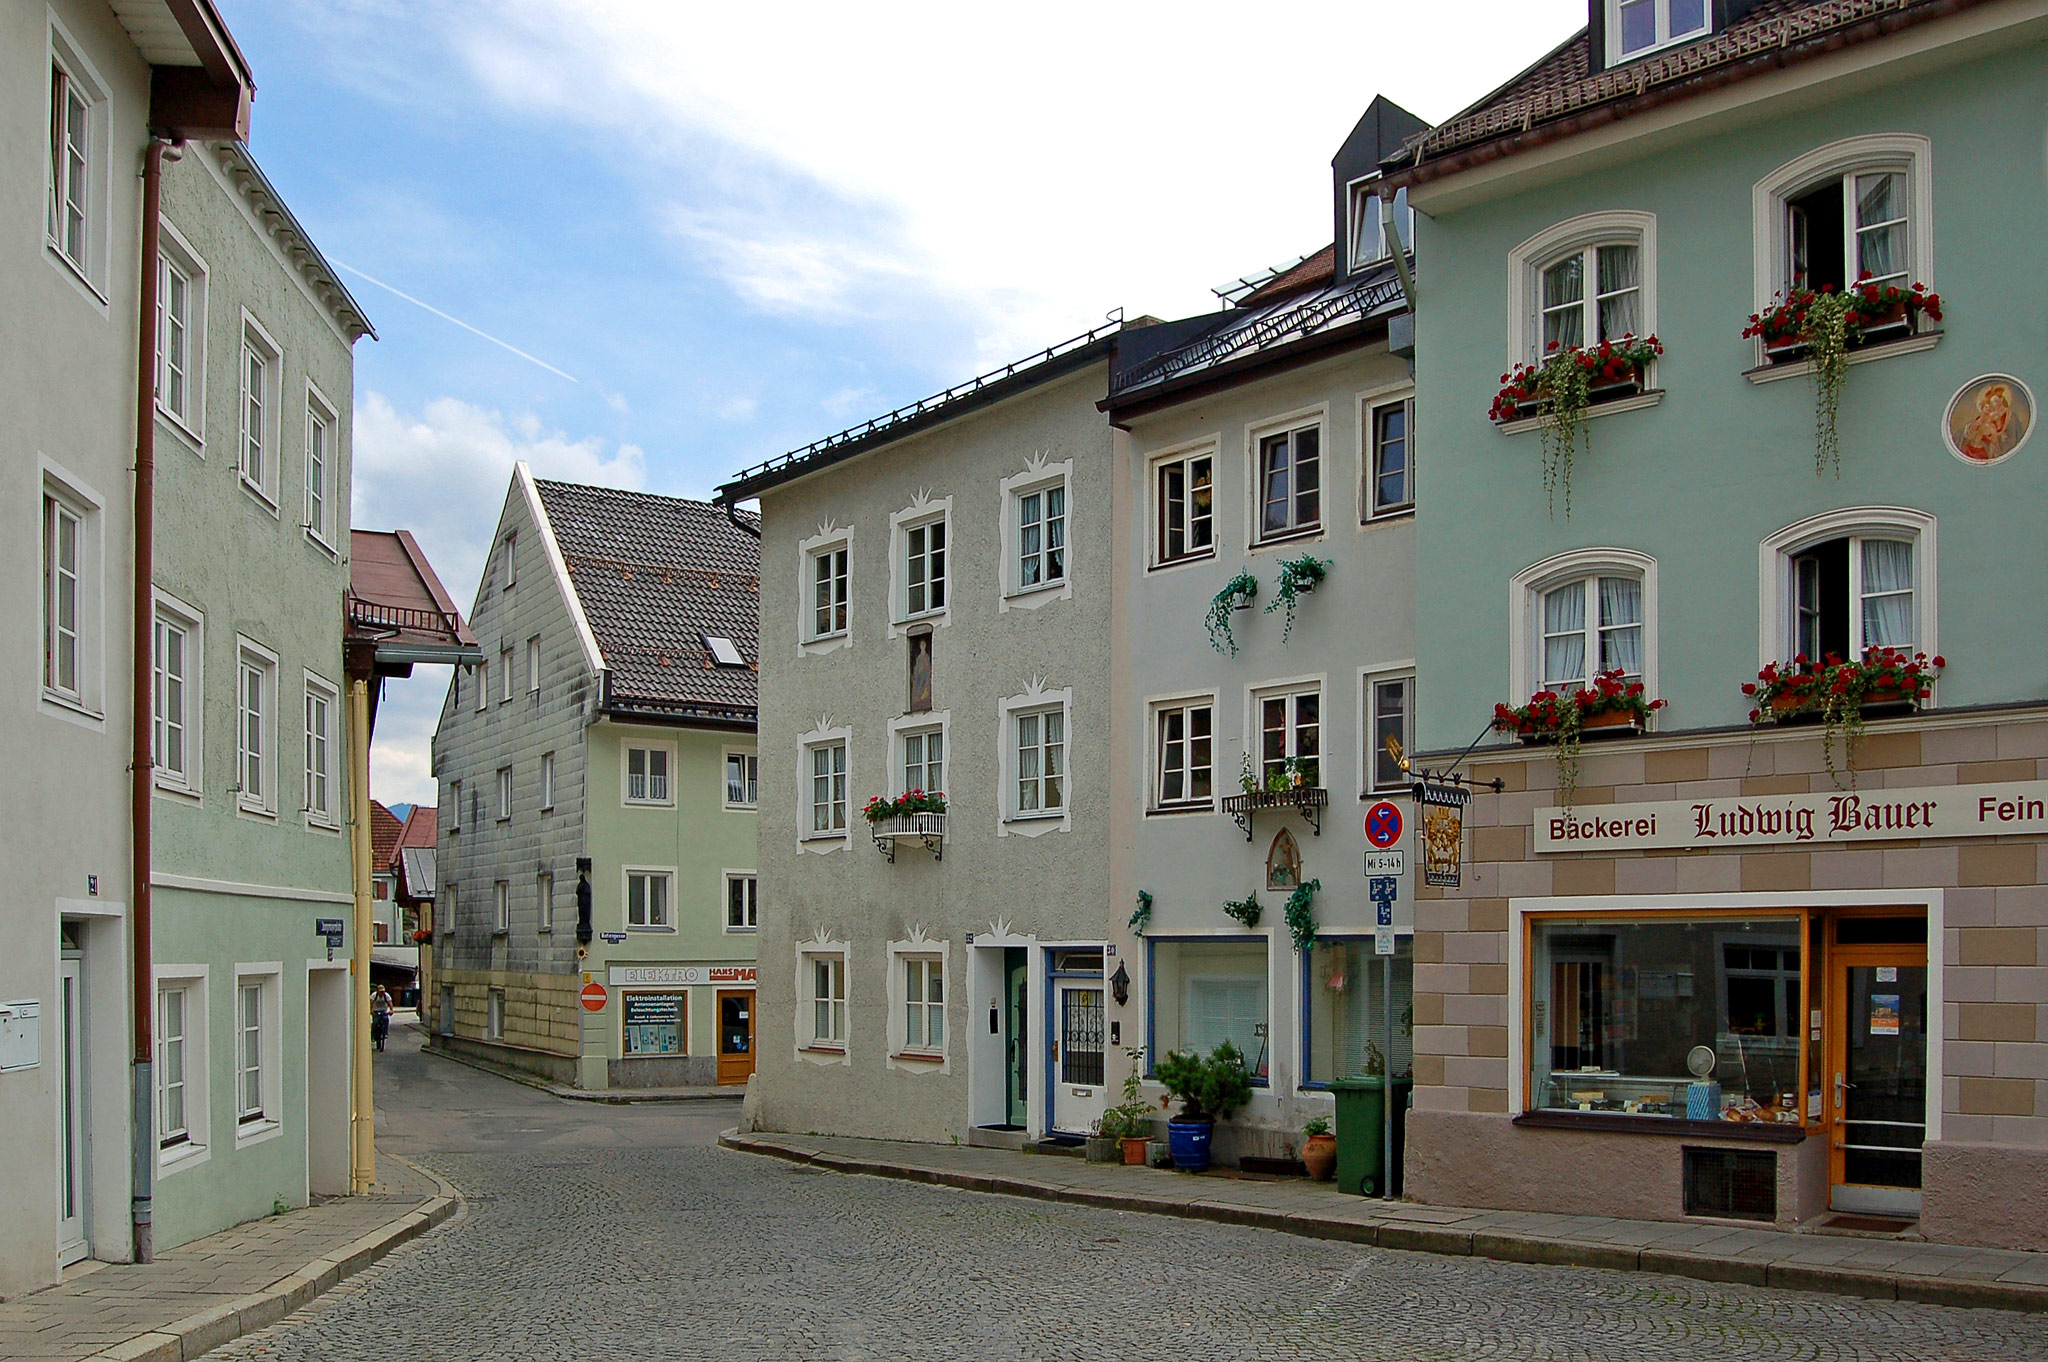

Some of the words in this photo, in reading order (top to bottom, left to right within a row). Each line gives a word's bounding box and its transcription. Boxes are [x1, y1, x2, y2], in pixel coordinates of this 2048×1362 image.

[1549, 813, 1657, 841] Bäckerei
[1690, 800, 1816, 841] Ludwig
[1827, 795, 1938, 839] Bauer
[1978, 795, 2048, 823] Fein
[1367, 858, 1376, 869] Mi
[1378, 857, 1395, 869] 5-14
[625, 968, 698, 982] ELEKTRO
